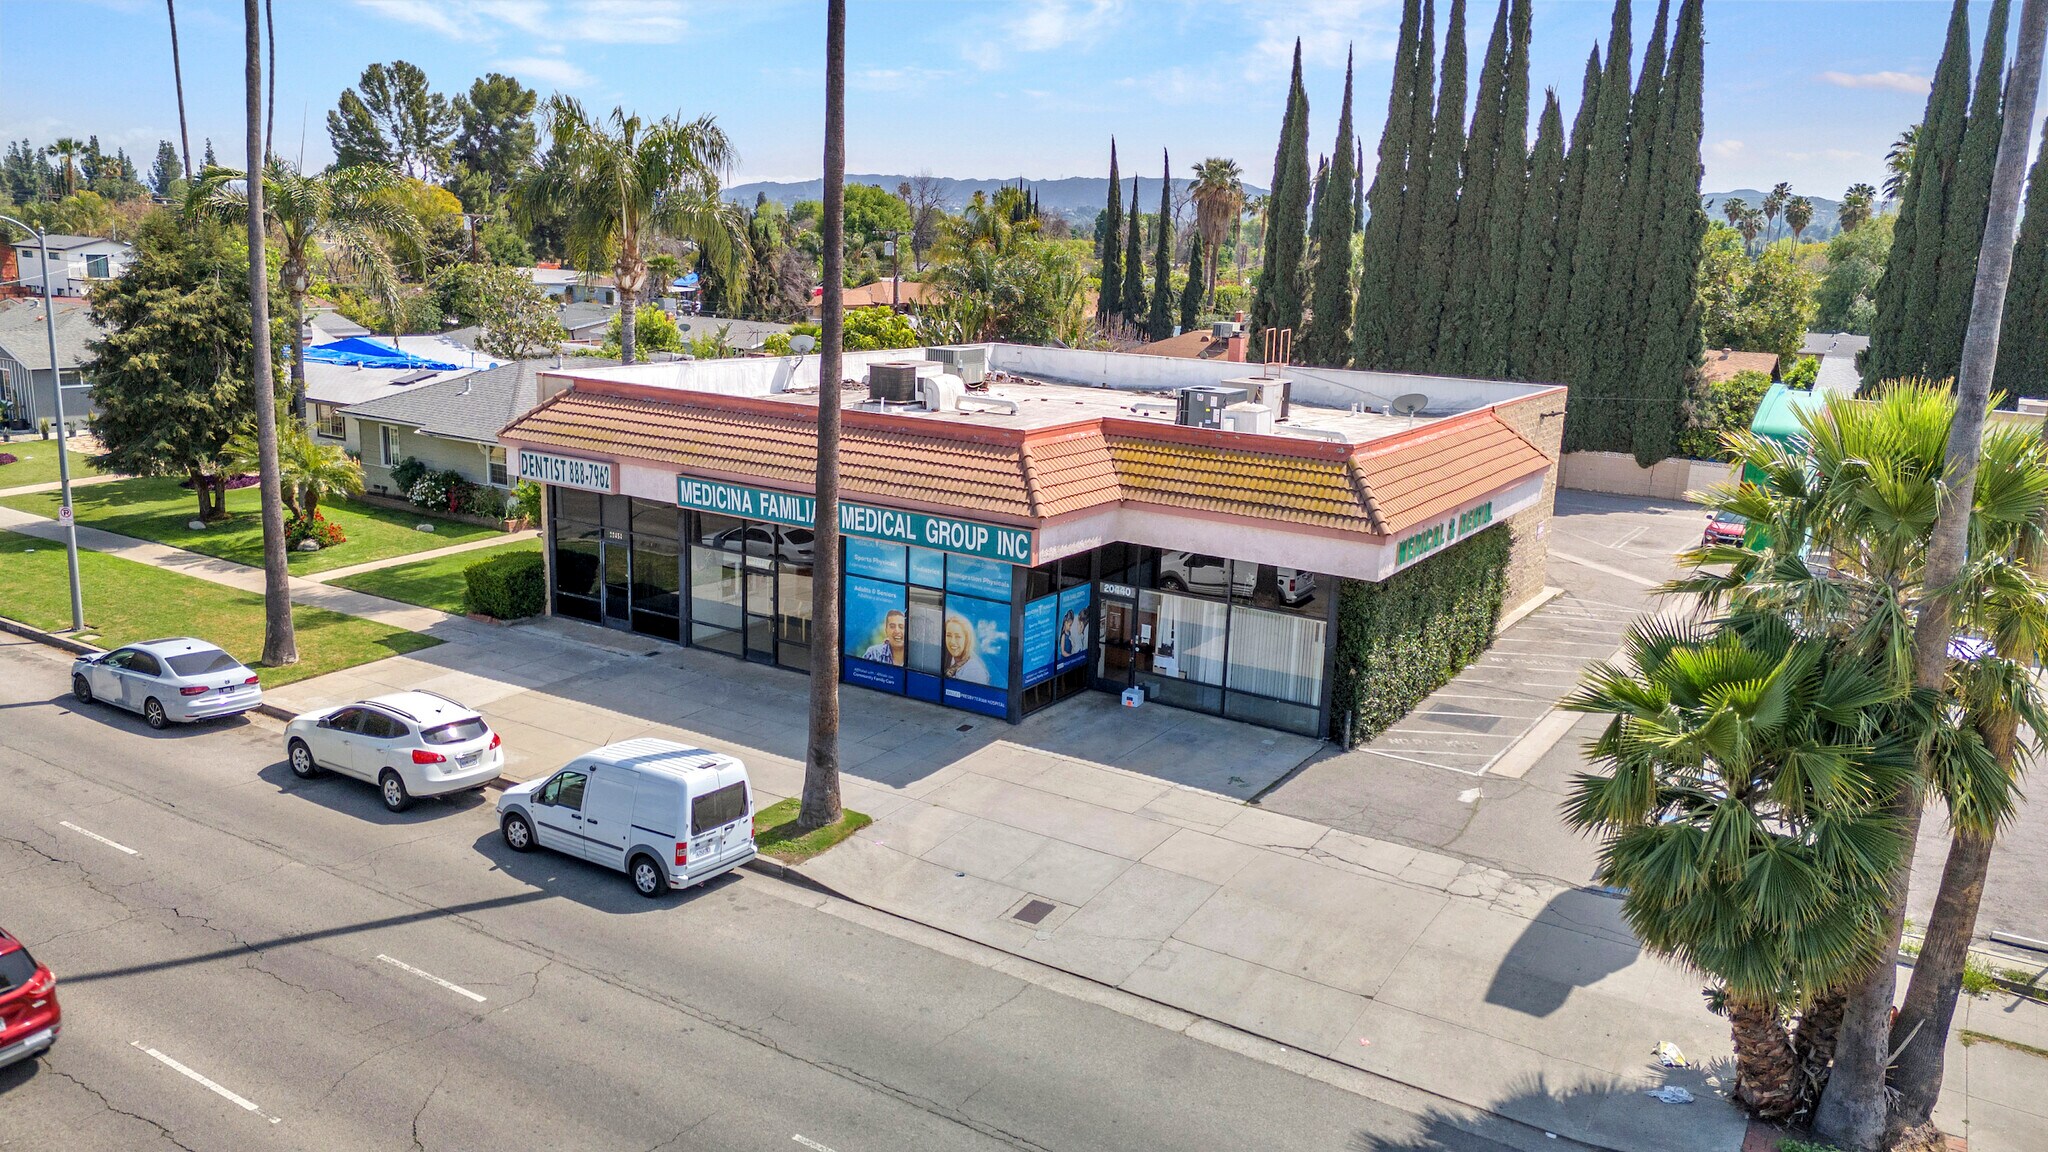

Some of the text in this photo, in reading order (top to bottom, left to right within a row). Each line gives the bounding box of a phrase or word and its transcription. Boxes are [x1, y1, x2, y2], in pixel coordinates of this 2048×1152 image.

[521, 453, 610, 489] DENTIST 888-7962
[680, 481, 753, 514] MEDICINA
[841, 505, 916, 541] MEDICAL
[925, 518, 989, 552] GROUP
[997, 530, 1029, 560] INC
[1395, 500, 1493, 566] MEDICAL & DENTAL
[853, 553, 897, 567] Sports Physicals
[947, 570, 983, 583] Immigration
[982, 577, 1010, 588] Physicals
[853, 585, 872, 594] Adults
[877, 590, 897, 599] Seniors
[1103, 583, 1132, 597] 20440
